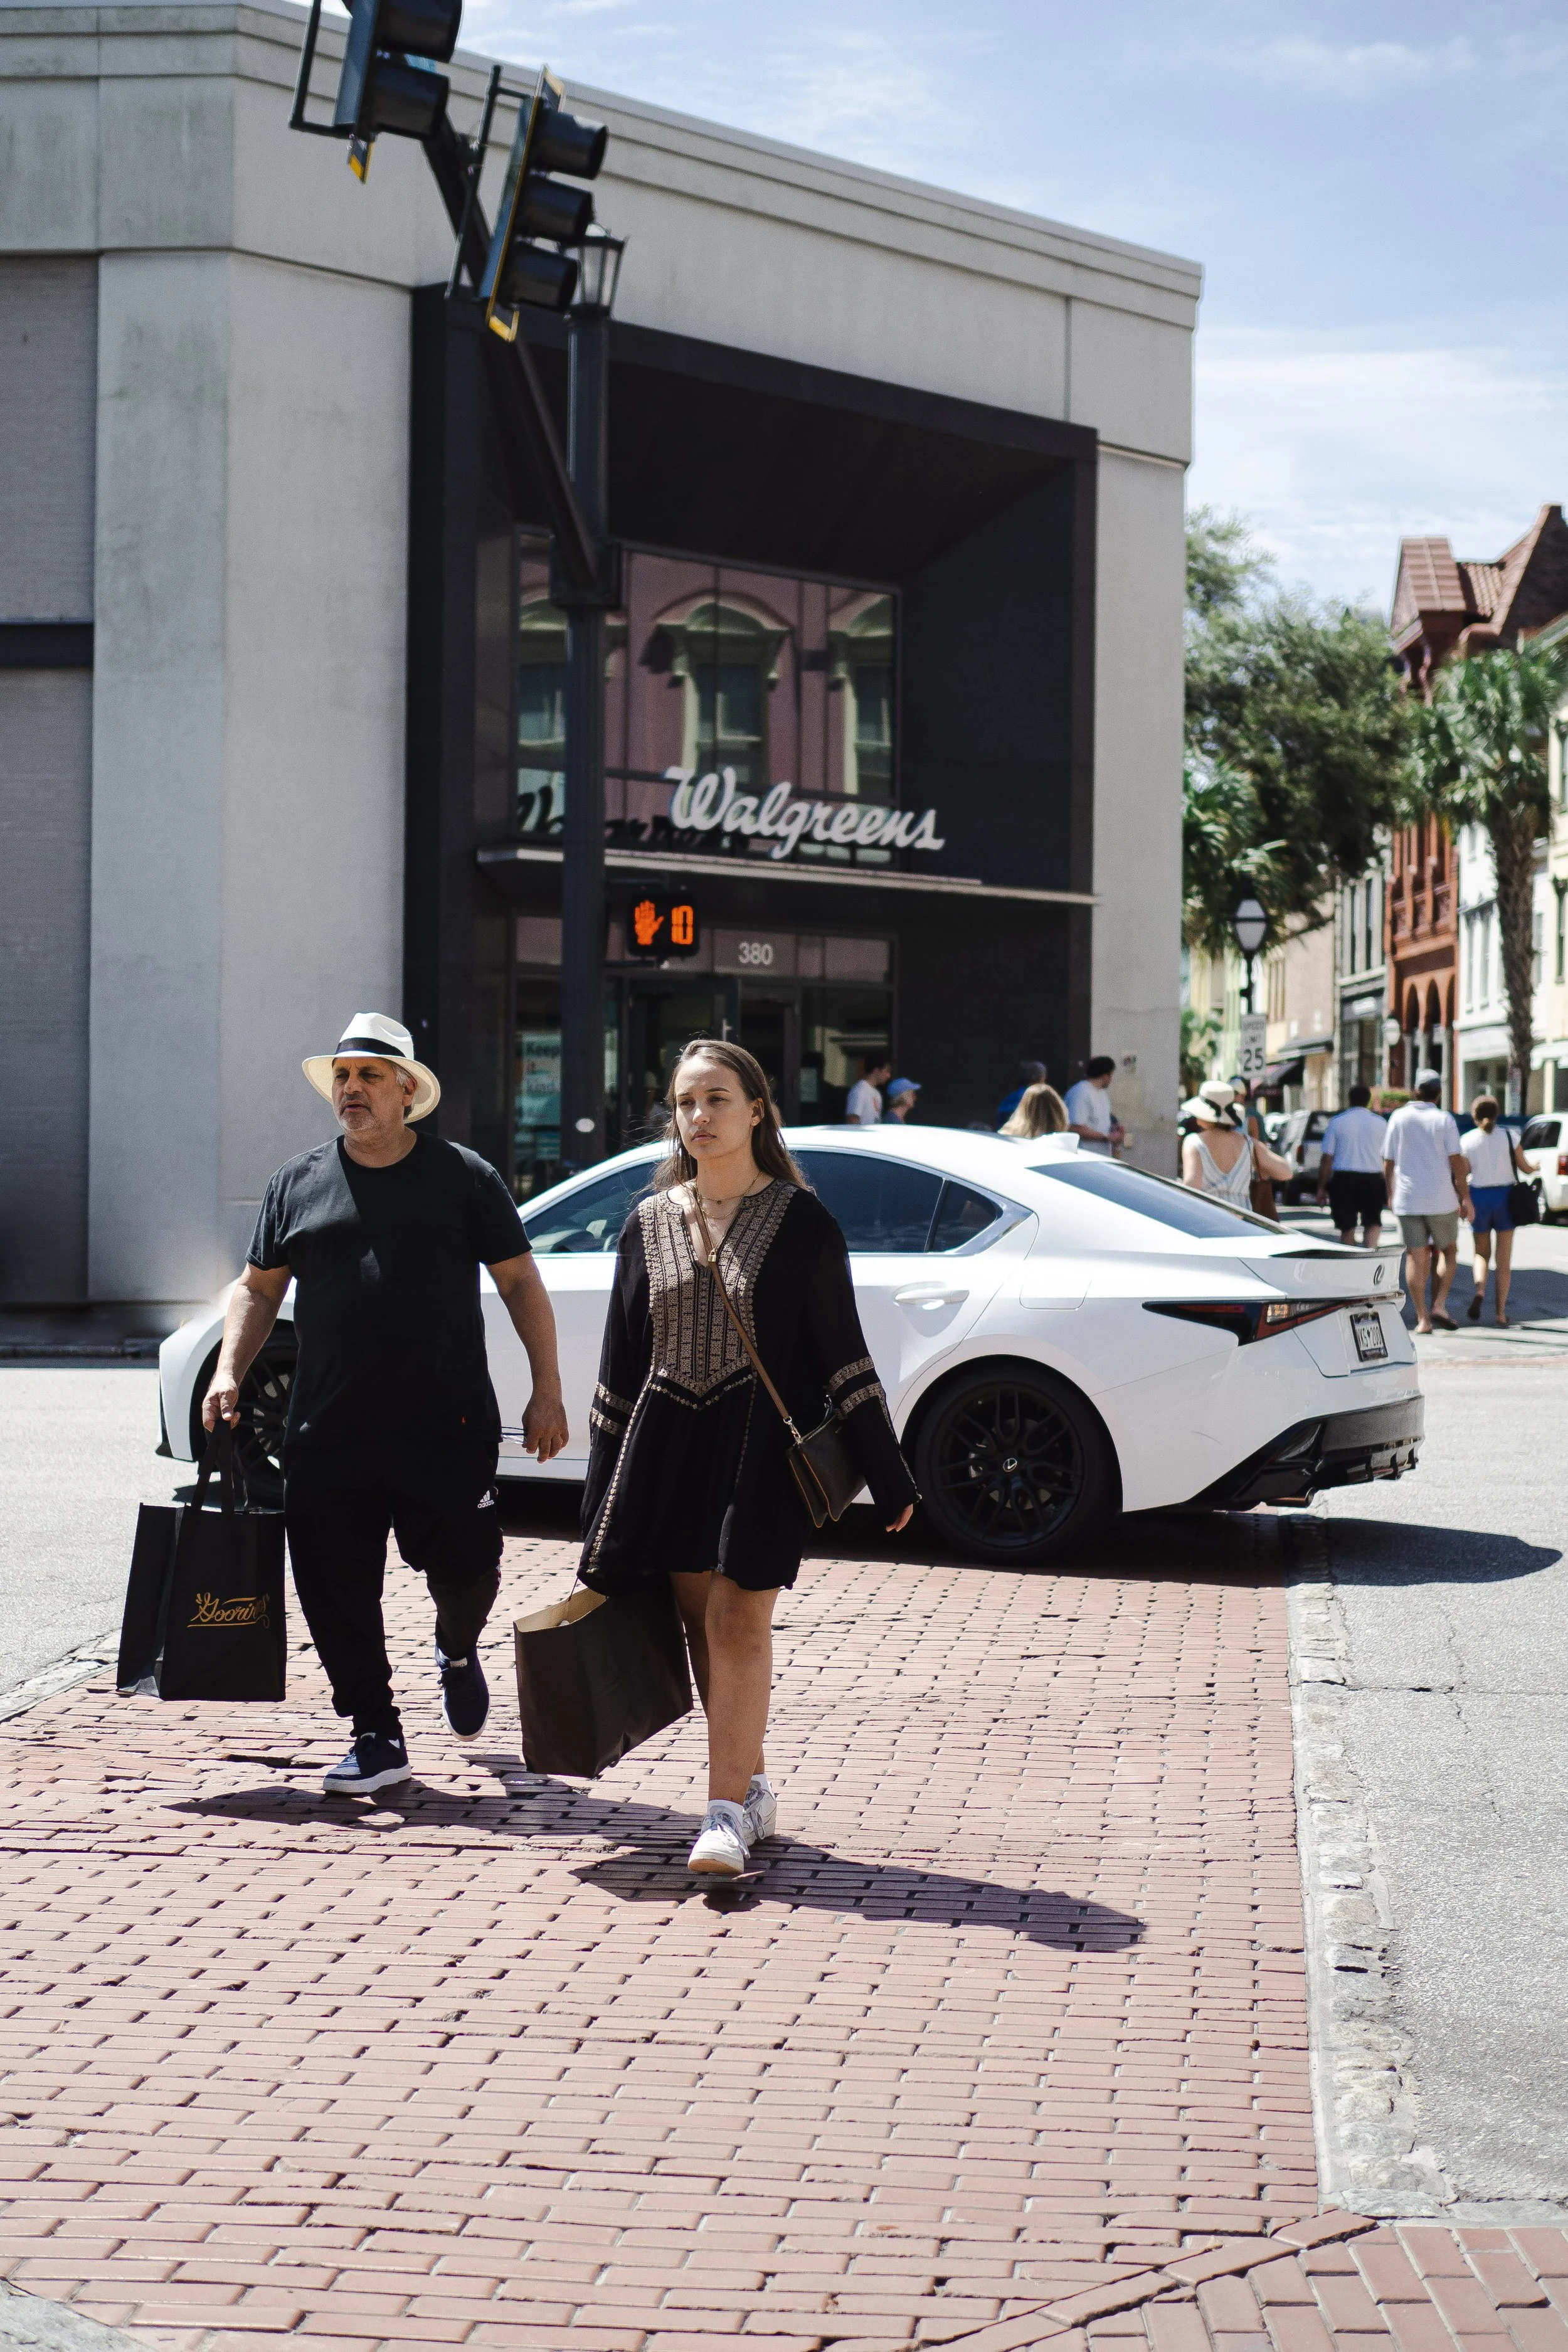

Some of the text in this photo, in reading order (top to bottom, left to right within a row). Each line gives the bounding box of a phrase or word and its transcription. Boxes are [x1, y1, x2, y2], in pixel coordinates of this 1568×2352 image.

[662, 766, 945, 859] Walgreens
[738, 941, 774, 965] 380
[1243, 1048, 1264, 1071] 25
